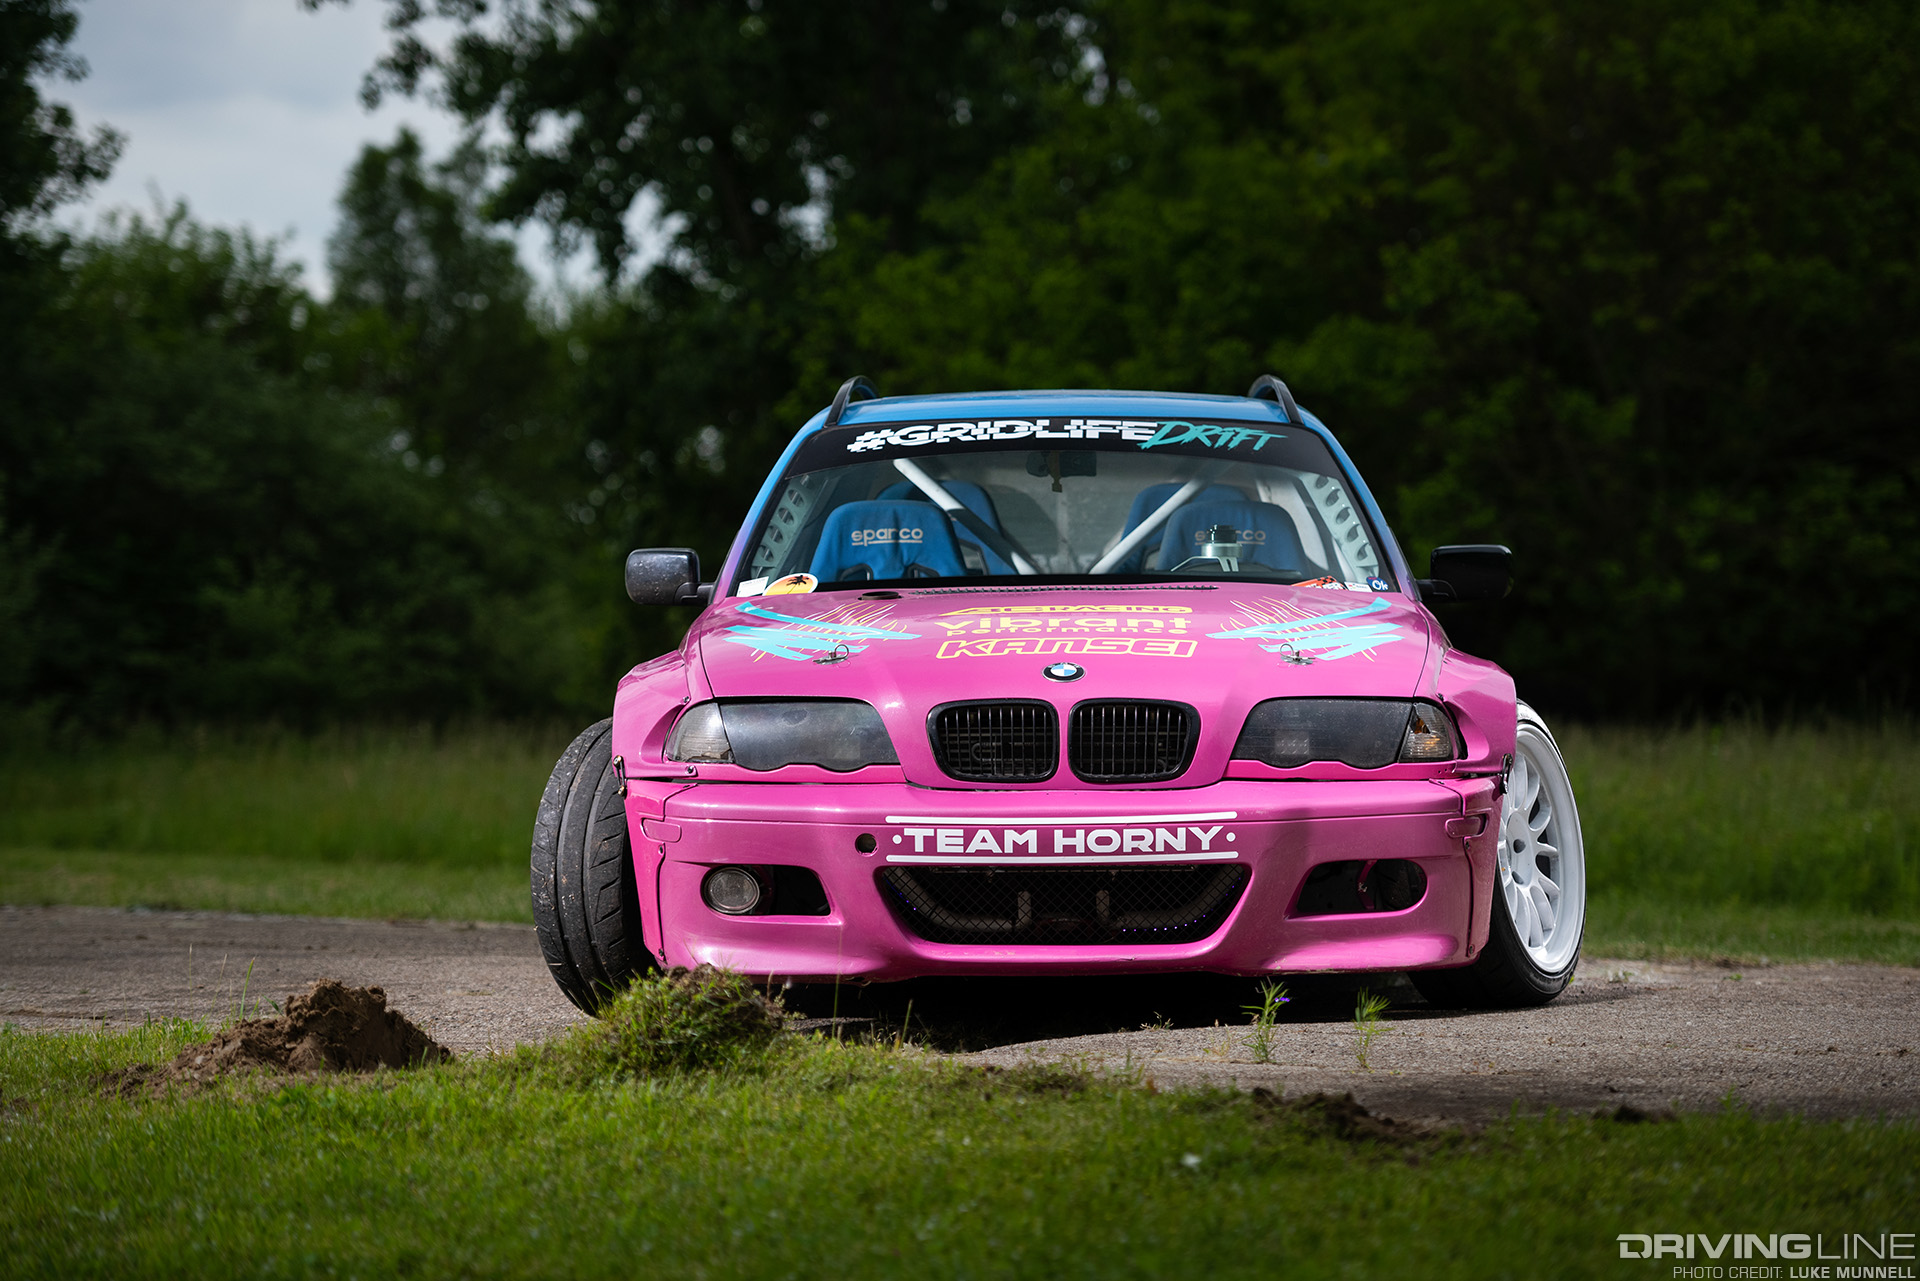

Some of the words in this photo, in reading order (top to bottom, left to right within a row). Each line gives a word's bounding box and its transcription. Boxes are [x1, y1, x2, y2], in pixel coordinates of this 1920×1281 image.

[851, 528, 923, 546] sparco
[934, 617, 1191, 629] vibrant
[947, 627, 1188, 636] performance
[904, 828, 1038, 853] TEAM
[1053, 826, 1224, 853] HORNY
